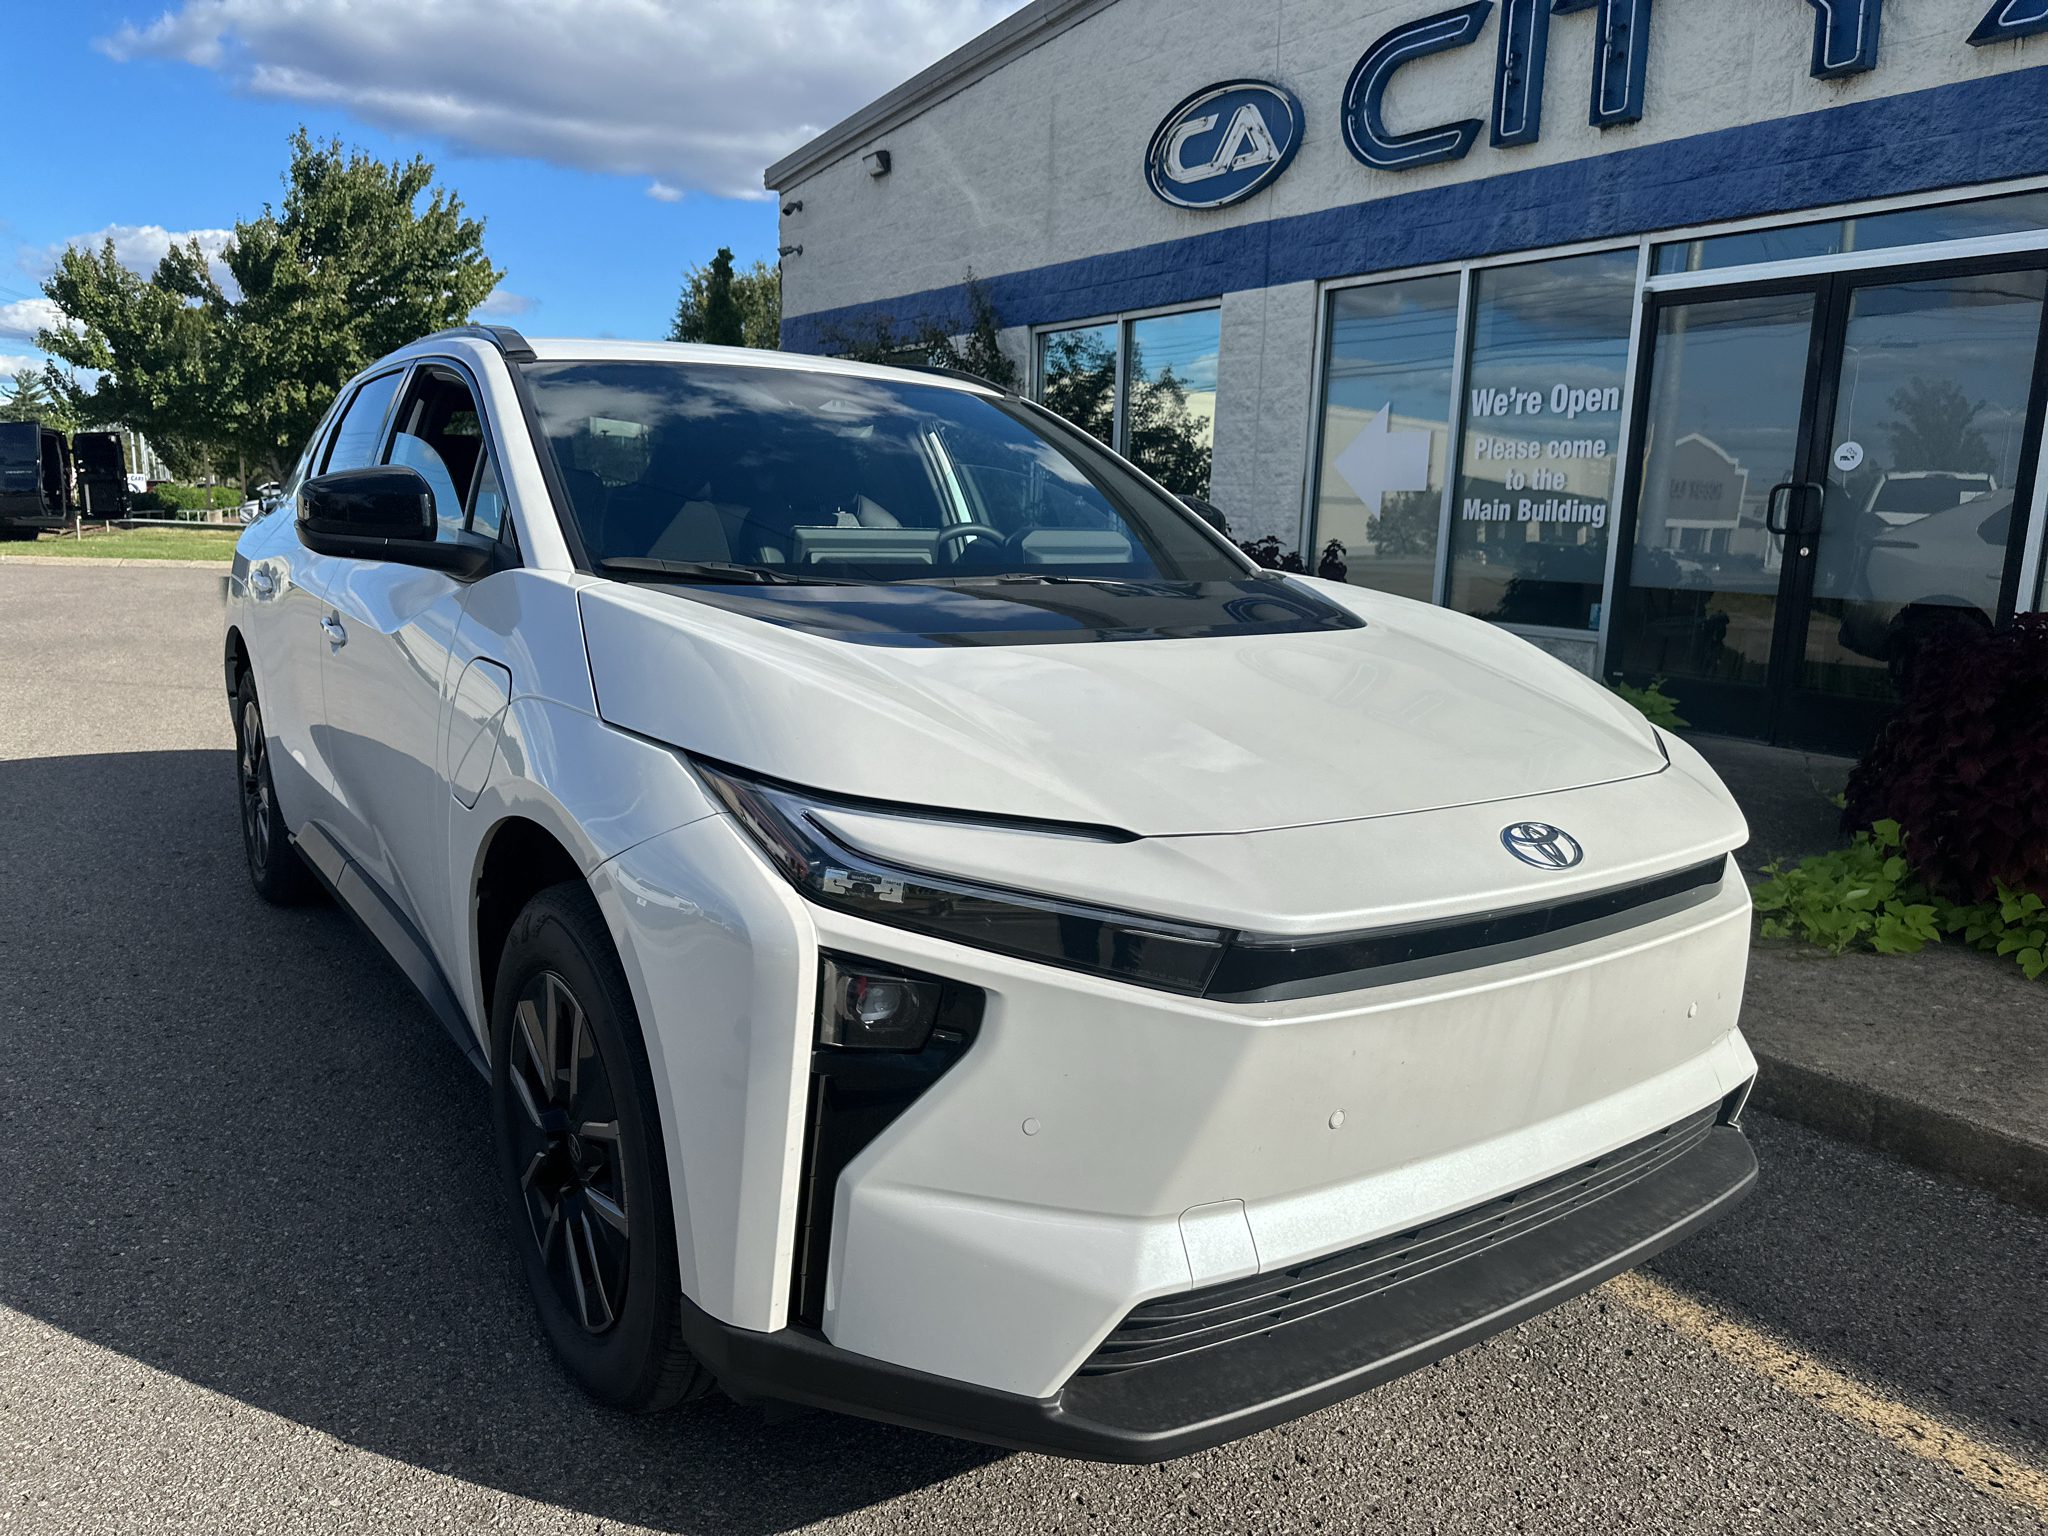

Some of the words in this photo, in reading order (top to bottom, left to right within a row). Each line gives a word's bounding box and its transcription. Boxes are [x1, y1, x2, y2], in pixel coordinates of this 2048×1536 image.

[1163, 103, 1281, 184] CA
[1472, 387, 1543, 417] We're
[1550, 383, 1620, 419] Open
[1474, 438, 1541, 460] Please
[1546, 438, 1606, 459] come
[1505, 468, 1525, 490] to
[1531, 467, 1565, 490] the
[1462, 498, 1511, 521] Main
[1517, 498, 1606, 528] Building
